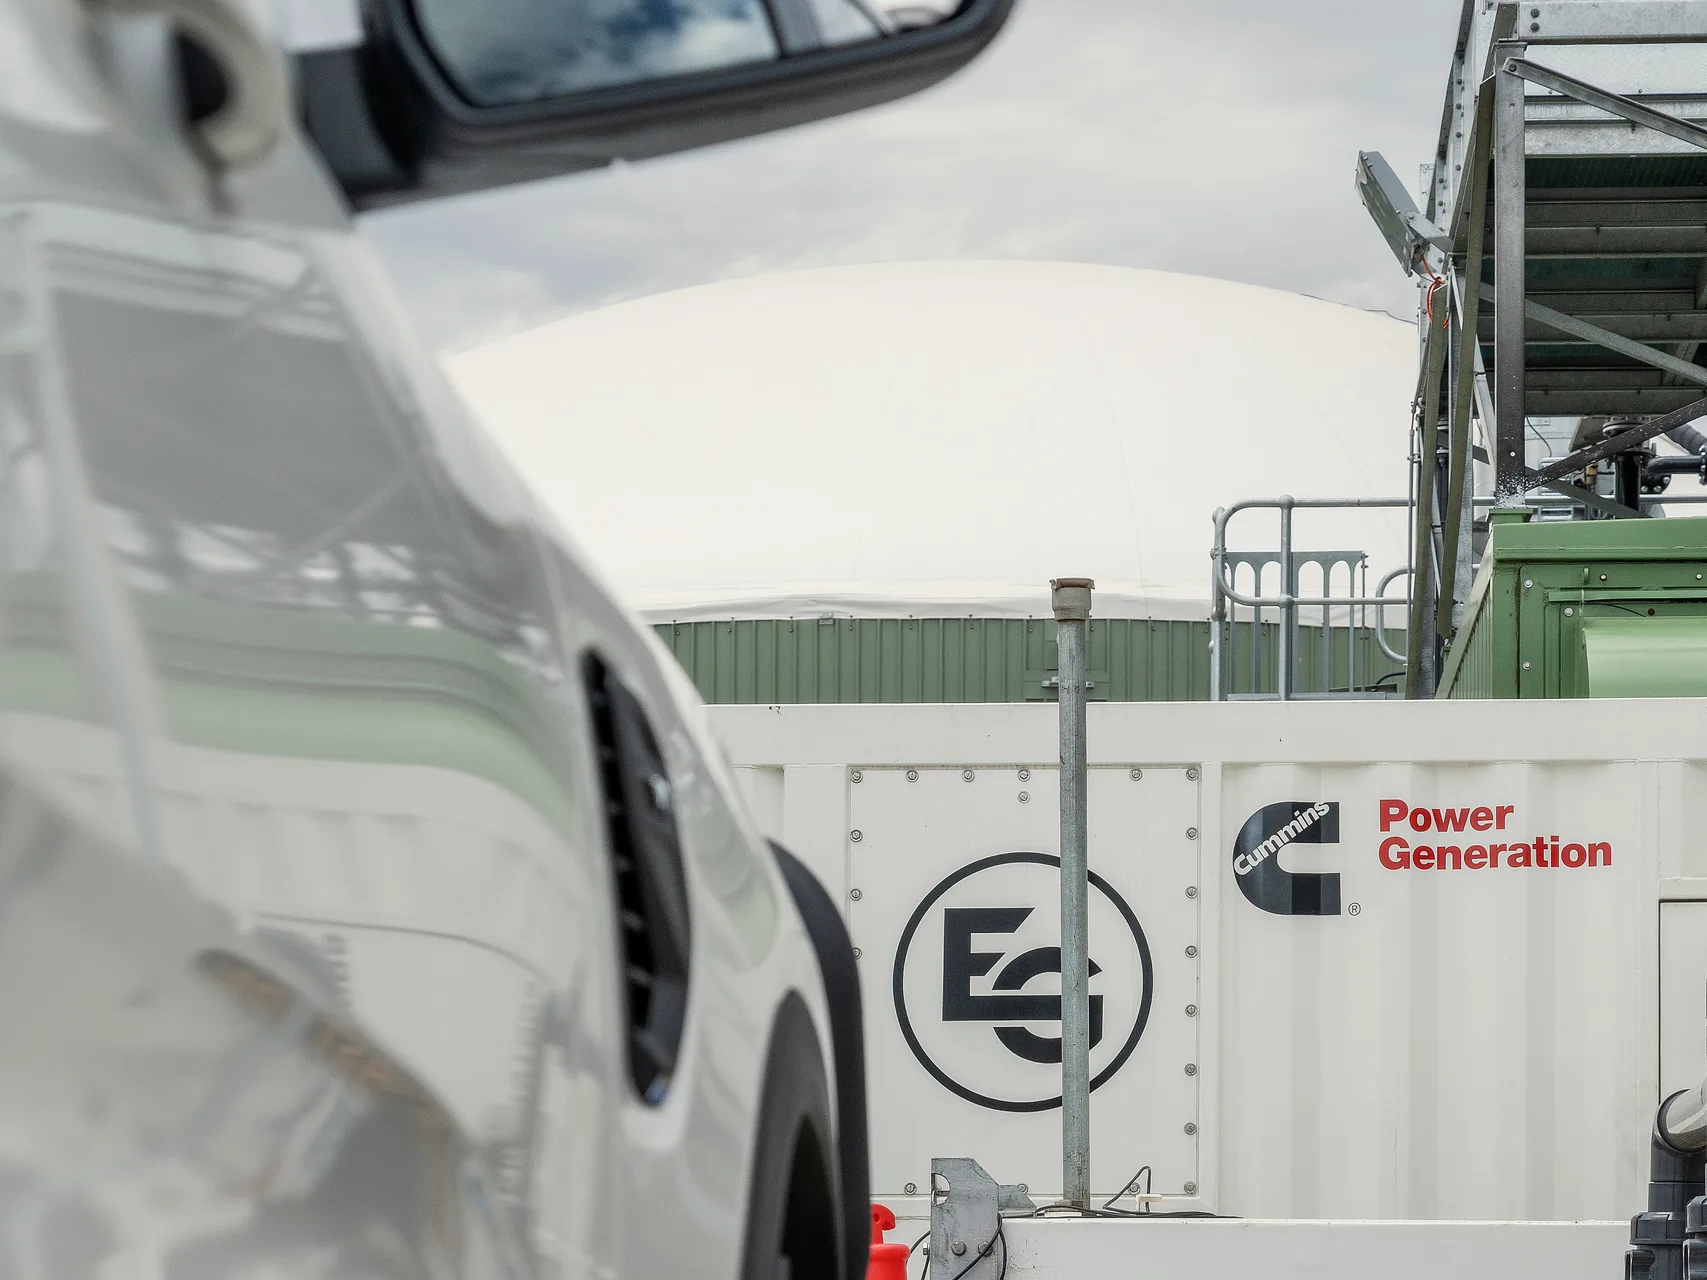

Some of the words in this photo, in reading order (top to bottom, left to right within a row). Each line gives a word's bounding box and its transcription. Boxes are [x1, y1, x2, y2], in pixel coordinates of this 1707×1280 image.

[1379, 799, 1514, 832] Power
[1233, 800, 1330, 876] Cummins
[1378, 836, 1612, 870] Generation
